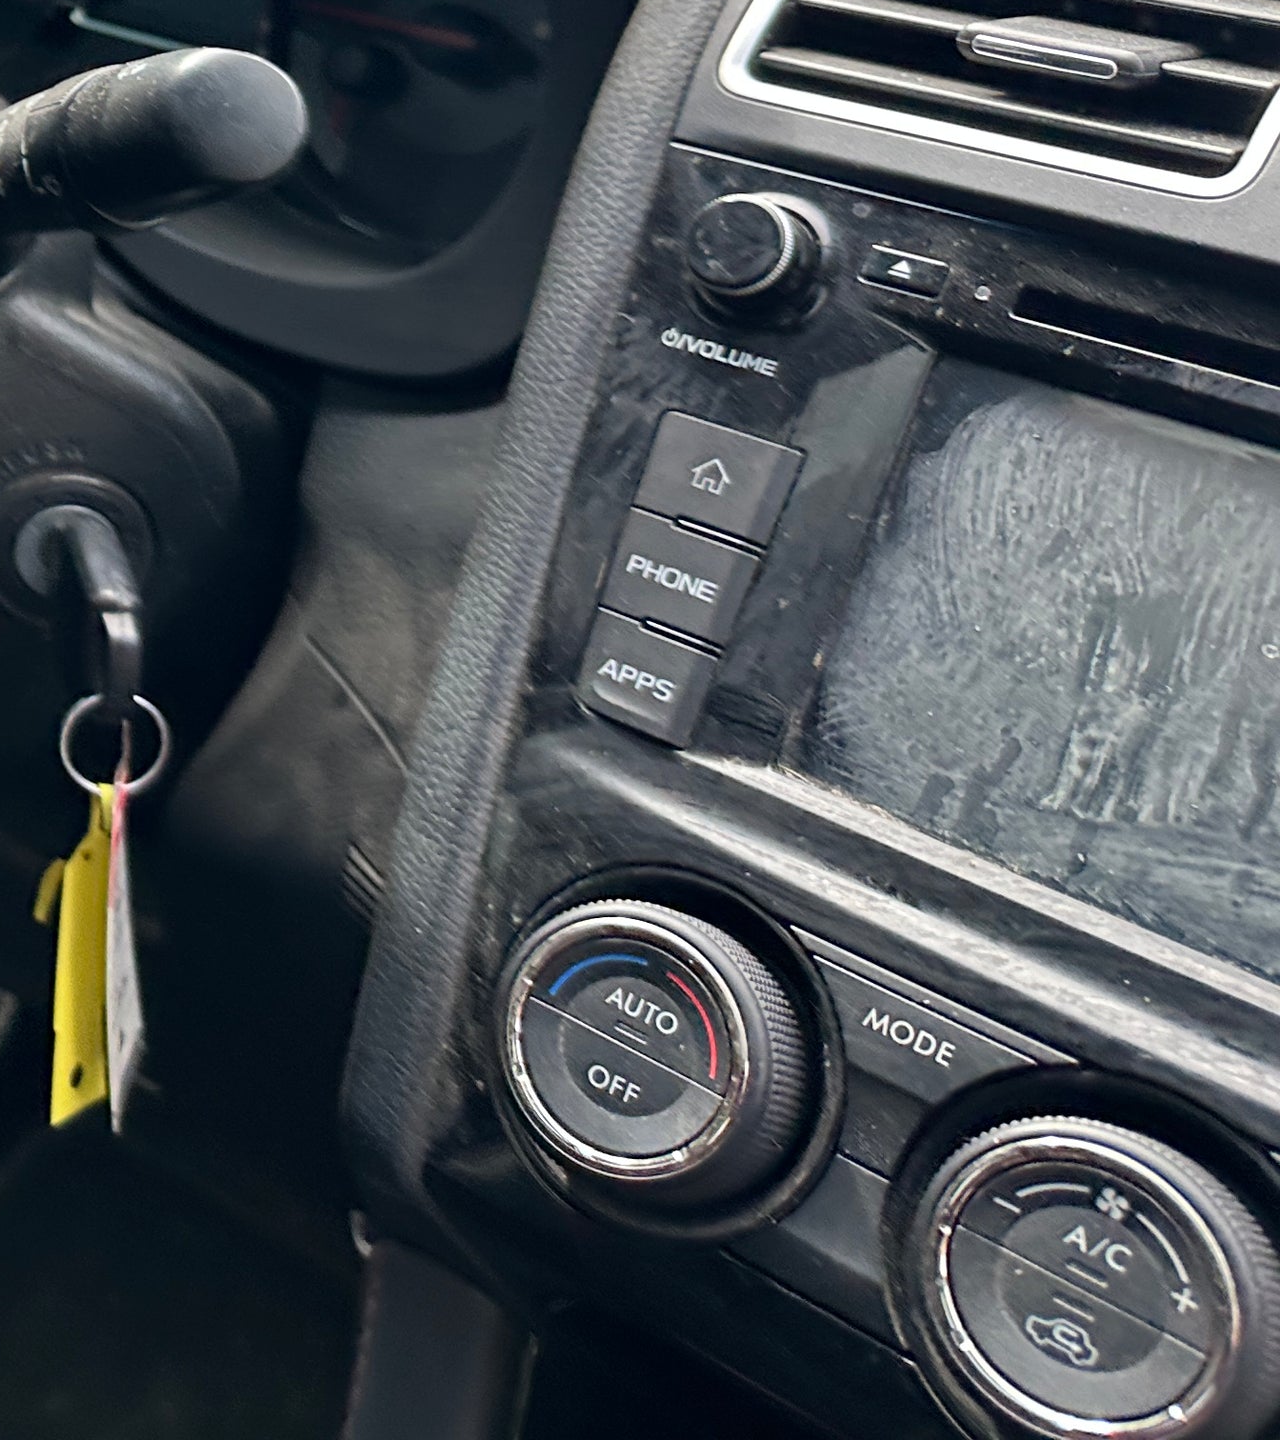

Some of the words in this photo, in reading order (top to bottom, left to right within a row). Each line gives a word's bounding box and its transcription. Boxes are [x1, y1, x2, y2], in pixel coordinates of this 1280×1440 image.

[625, 553, 720, 604] PHONE
[597, 658, 677, 703] APPS
[604, 987, 679, 1035] AUTO
[862, 1007, 957, 1068] MODE
[587, 1064, 641, 1103] OFF
[1062, 1225, 1133, 1274] A/C
